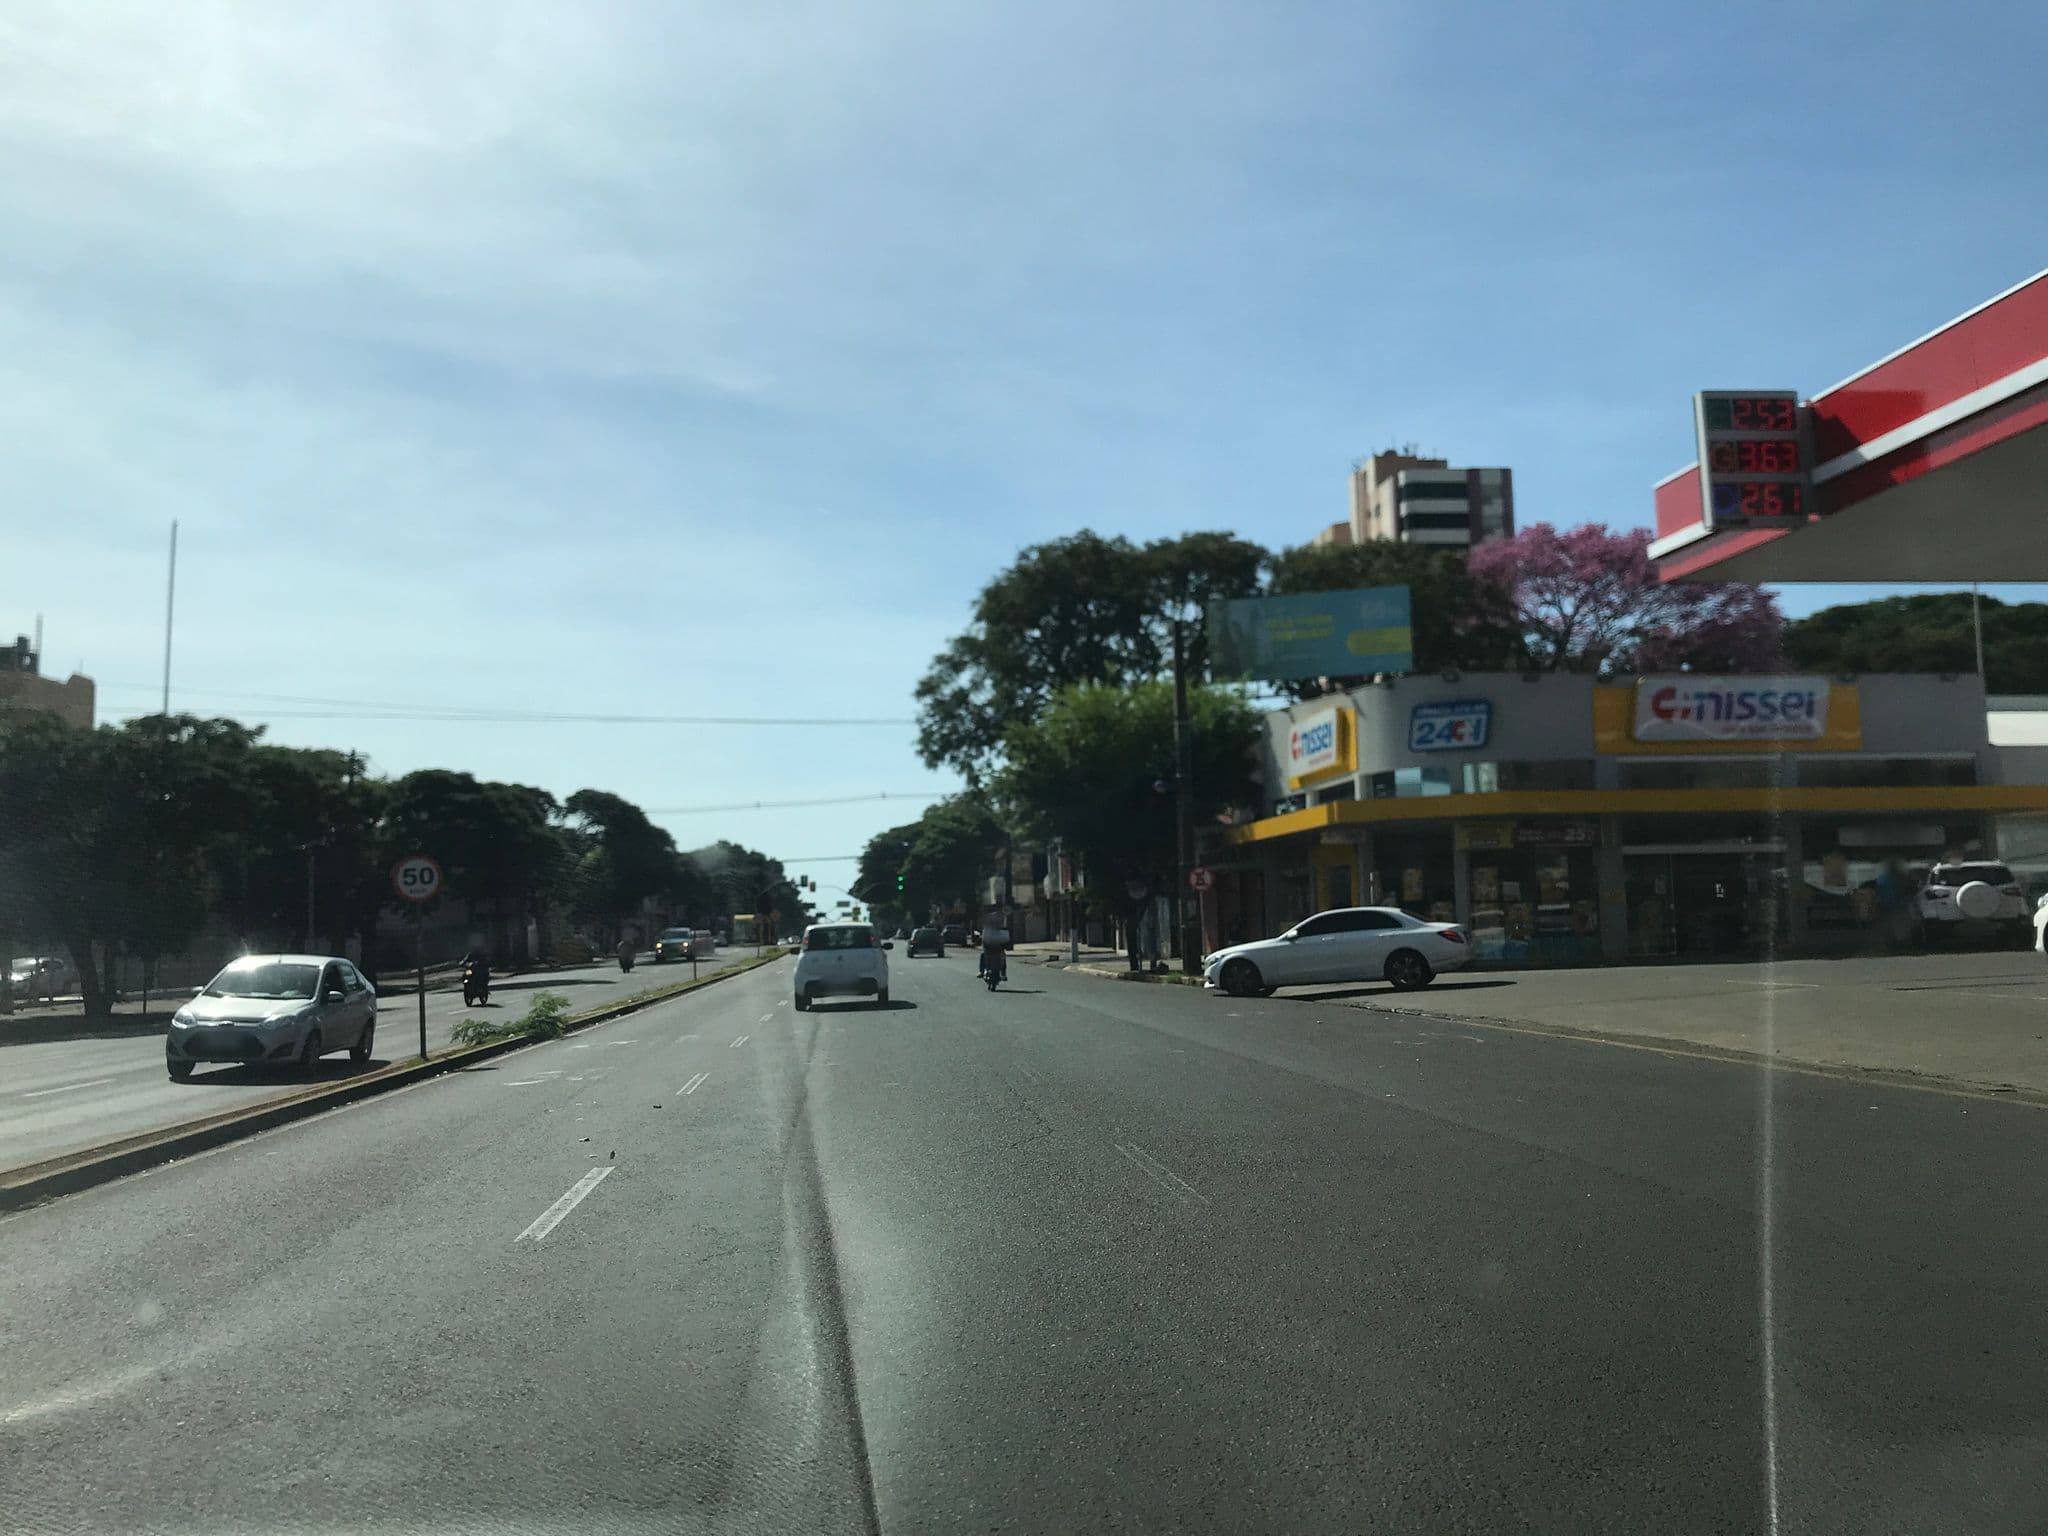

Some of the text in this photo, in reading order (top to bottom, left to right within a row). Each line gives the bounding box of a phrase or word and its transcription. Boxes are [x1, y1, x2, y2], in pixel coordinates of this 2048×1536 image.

[1737, 441, 1799, 473] 363
[1740, 482, 1802, 516] 261
[402, 866, 435, 887] 50
